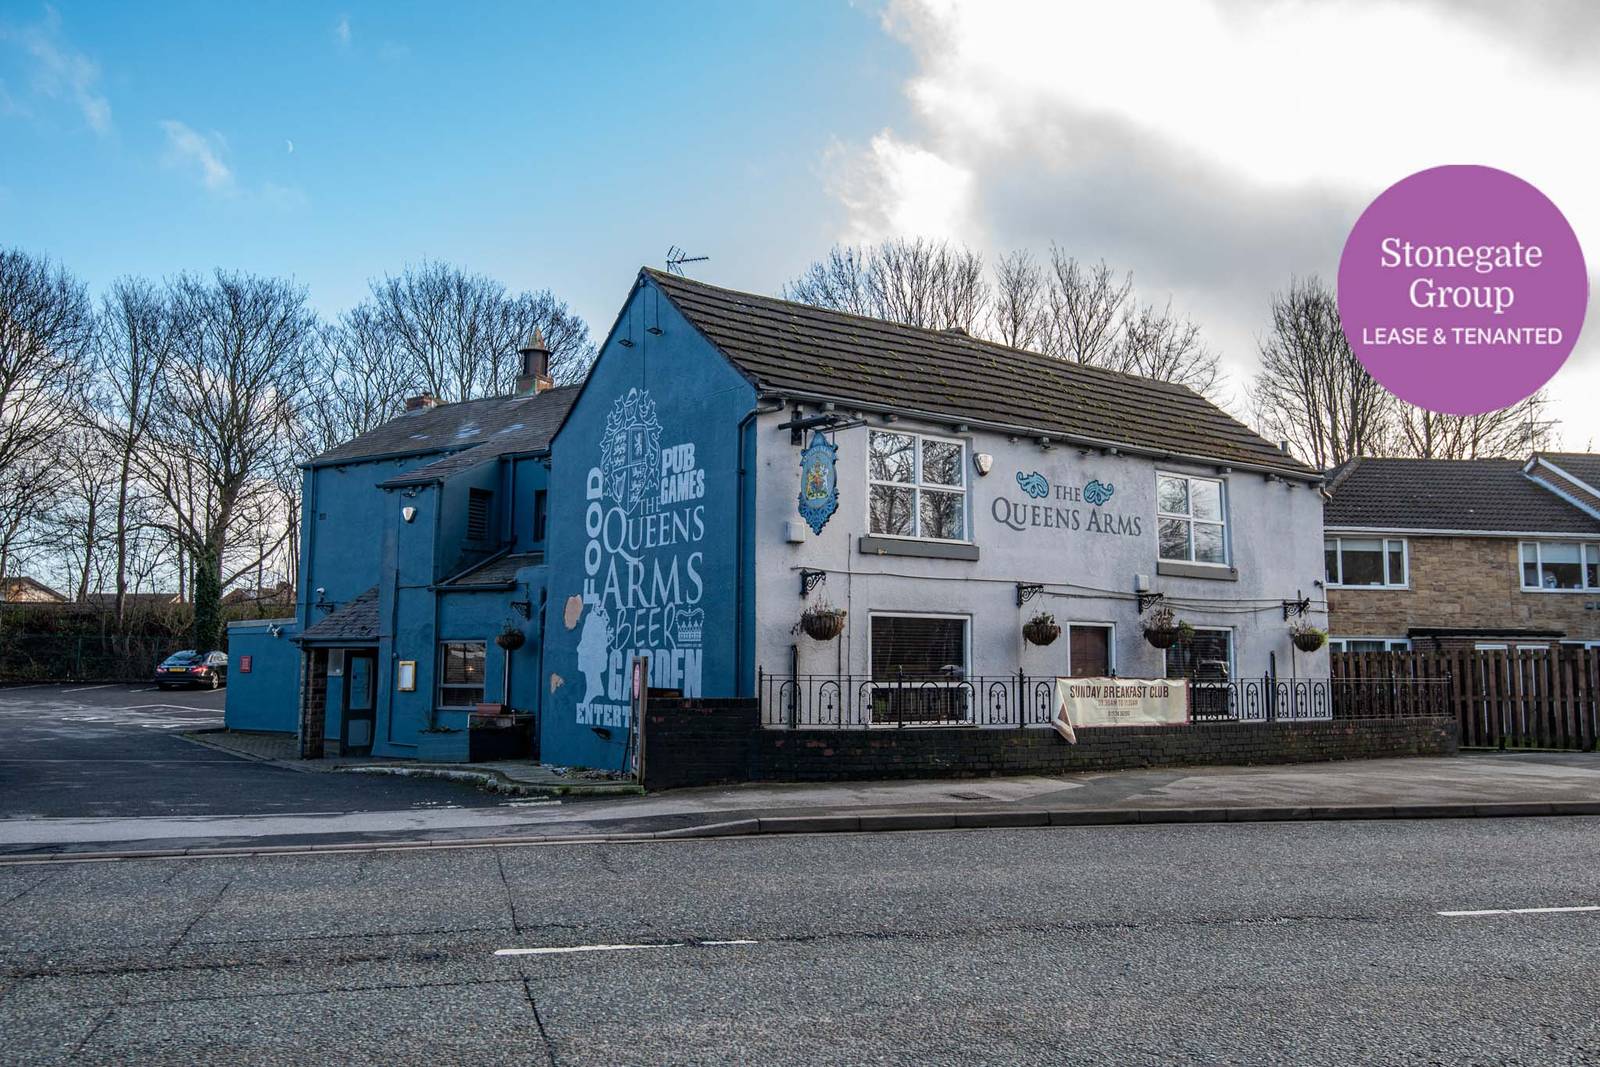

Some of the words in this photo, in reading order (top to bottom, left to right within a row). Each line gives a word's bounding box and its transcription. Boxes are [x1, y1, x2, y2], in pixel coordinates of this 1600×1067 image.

[661, 442, 695, 477] PUB
[640, 496, 661, 515] THE
[660, 468, 705, 505] GAMES
[1054, 485, 1081, 502] THE
[583, 466, 604, 604] FOOD
[603, 505, 705, 560] QUEENS
[991, 497, 1080, 531] QUEENS
[1085, 508, 1142, 536] ARMS
[601, 551, 703, 609] ARMS
[610, 602, 677, 651] BEER
[1070, 685, 1102, 698] SUNDAY
[1103, 685, 1147, 698] BREAKFAST
[1149, 685, 1169, 698] CLUB
